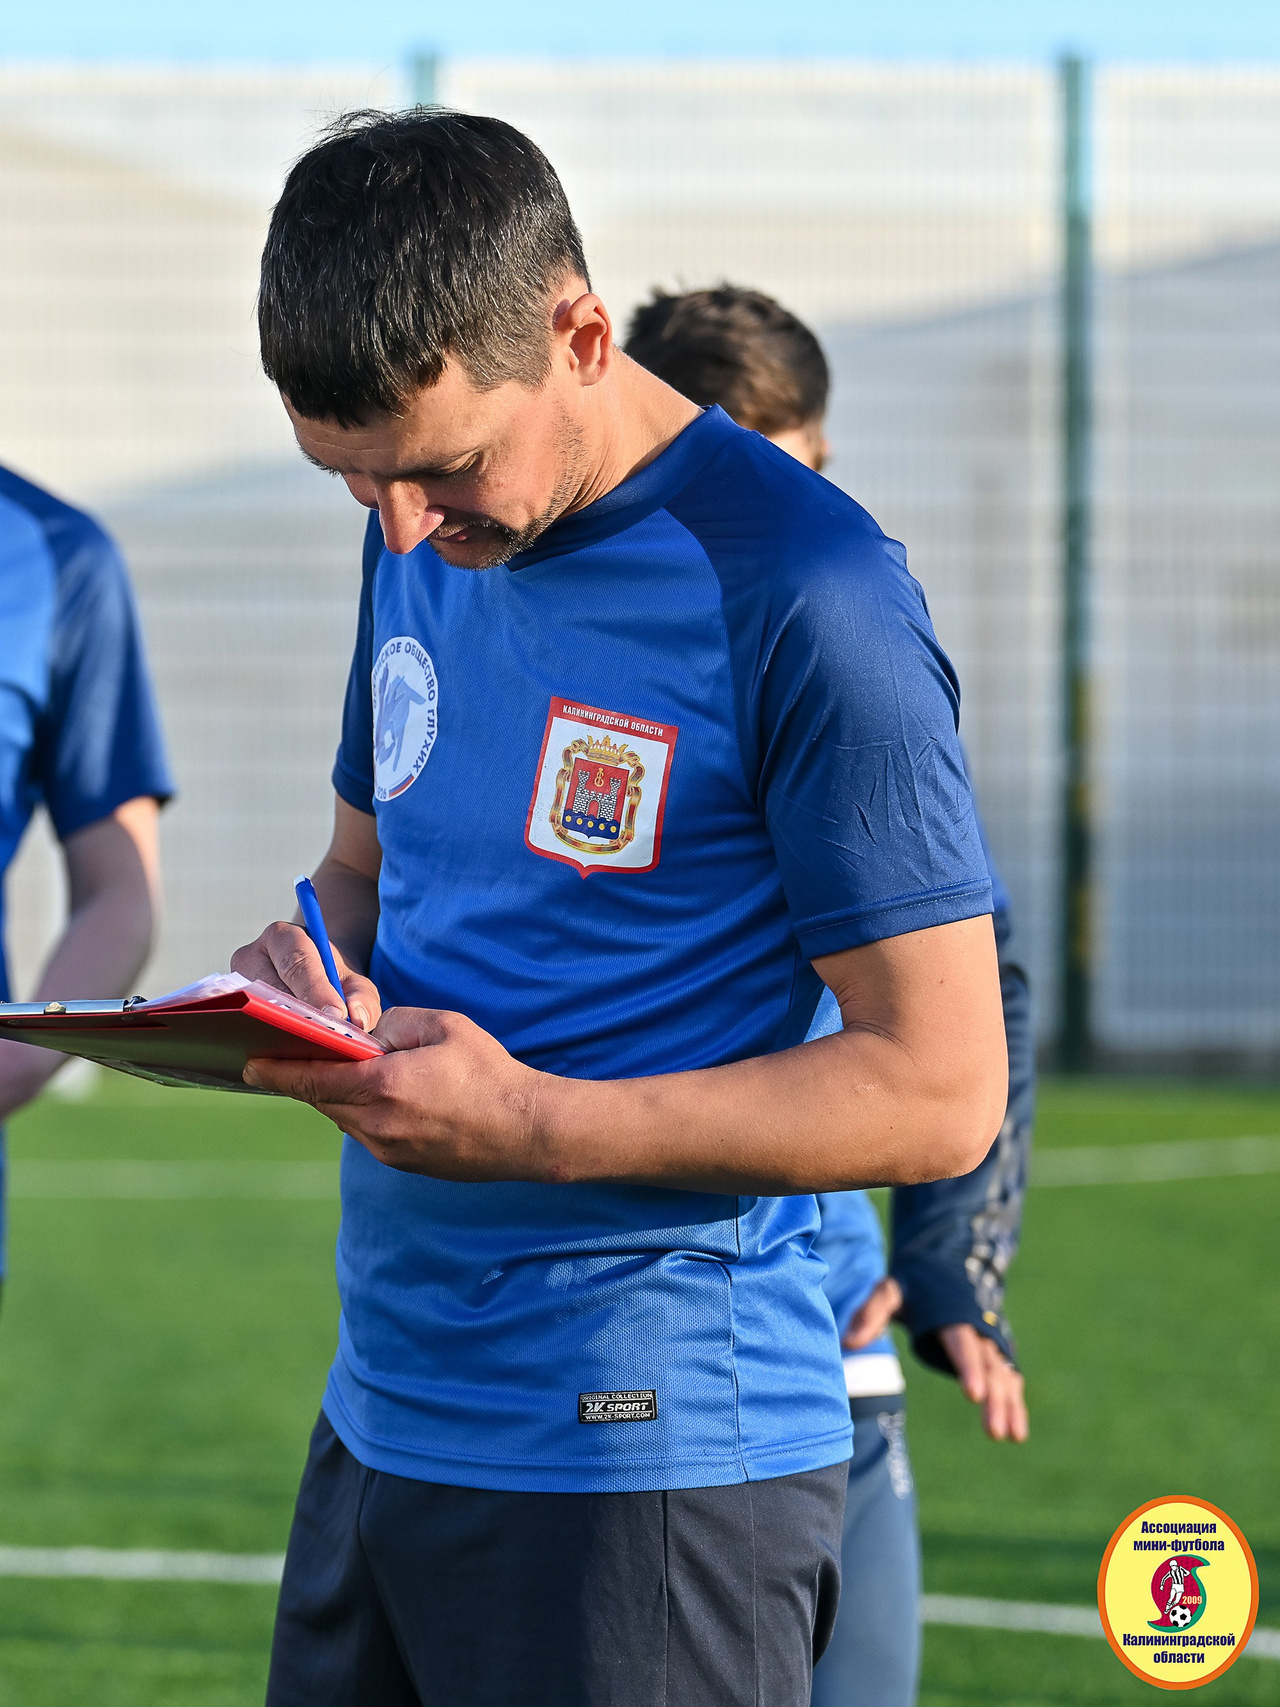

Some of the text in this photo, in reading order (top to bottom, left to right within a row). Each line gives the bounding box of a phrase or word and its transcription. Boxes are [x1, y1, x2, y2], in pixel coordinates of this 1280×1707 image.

[404, 641, 436, 701] ОБЩЕСТВО
[413, 709, 436, 773] ГЛУХИХ
[562, 705, 664, 736] КАЛИНИНГРАДСКОЙ ОБЛАСТИ
[585, 1402, 649, 1412] 2K SPORT
